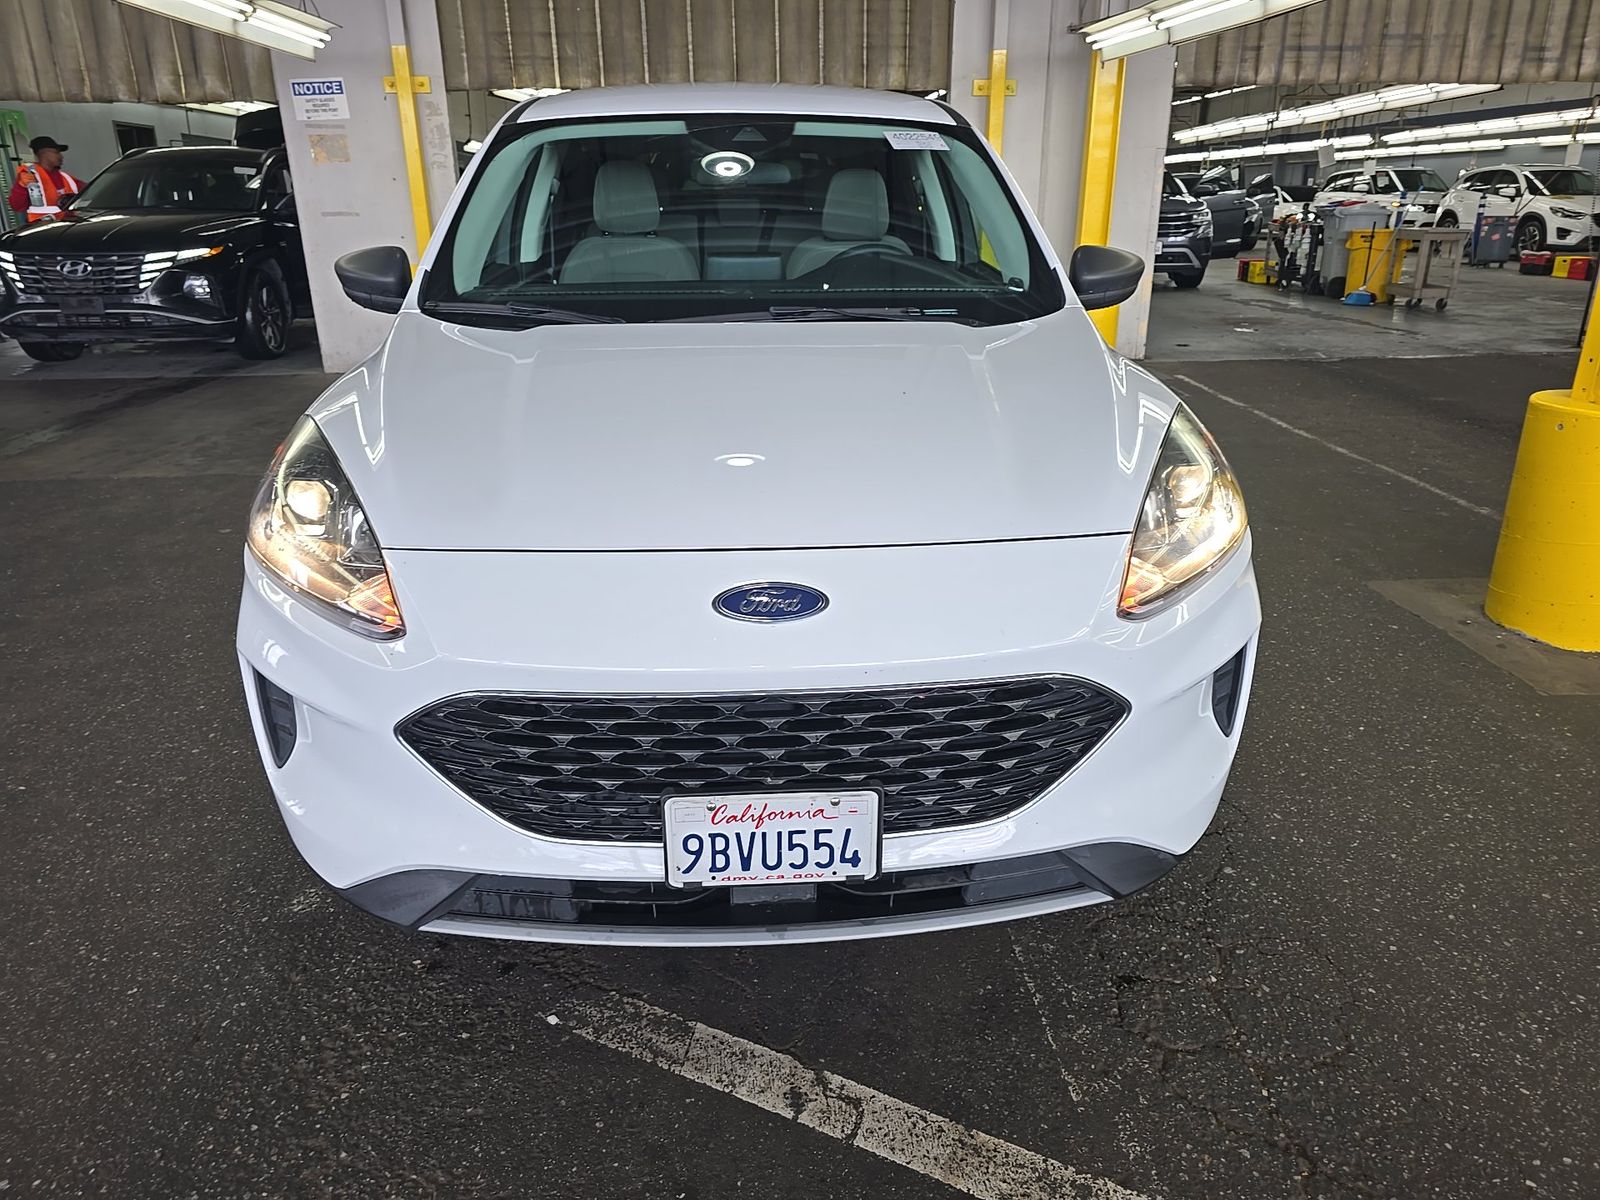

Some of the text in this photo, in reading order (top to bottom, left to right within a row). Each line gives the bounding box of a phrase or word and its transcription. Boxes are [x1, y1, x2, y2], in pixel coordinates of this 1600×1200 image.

[293, 82, 342, 95] NOTICE
[740, 588, 803, 613] Ford
[711, 802, 838, 830] California
[681, 828, 862, 875] 9BVU554
